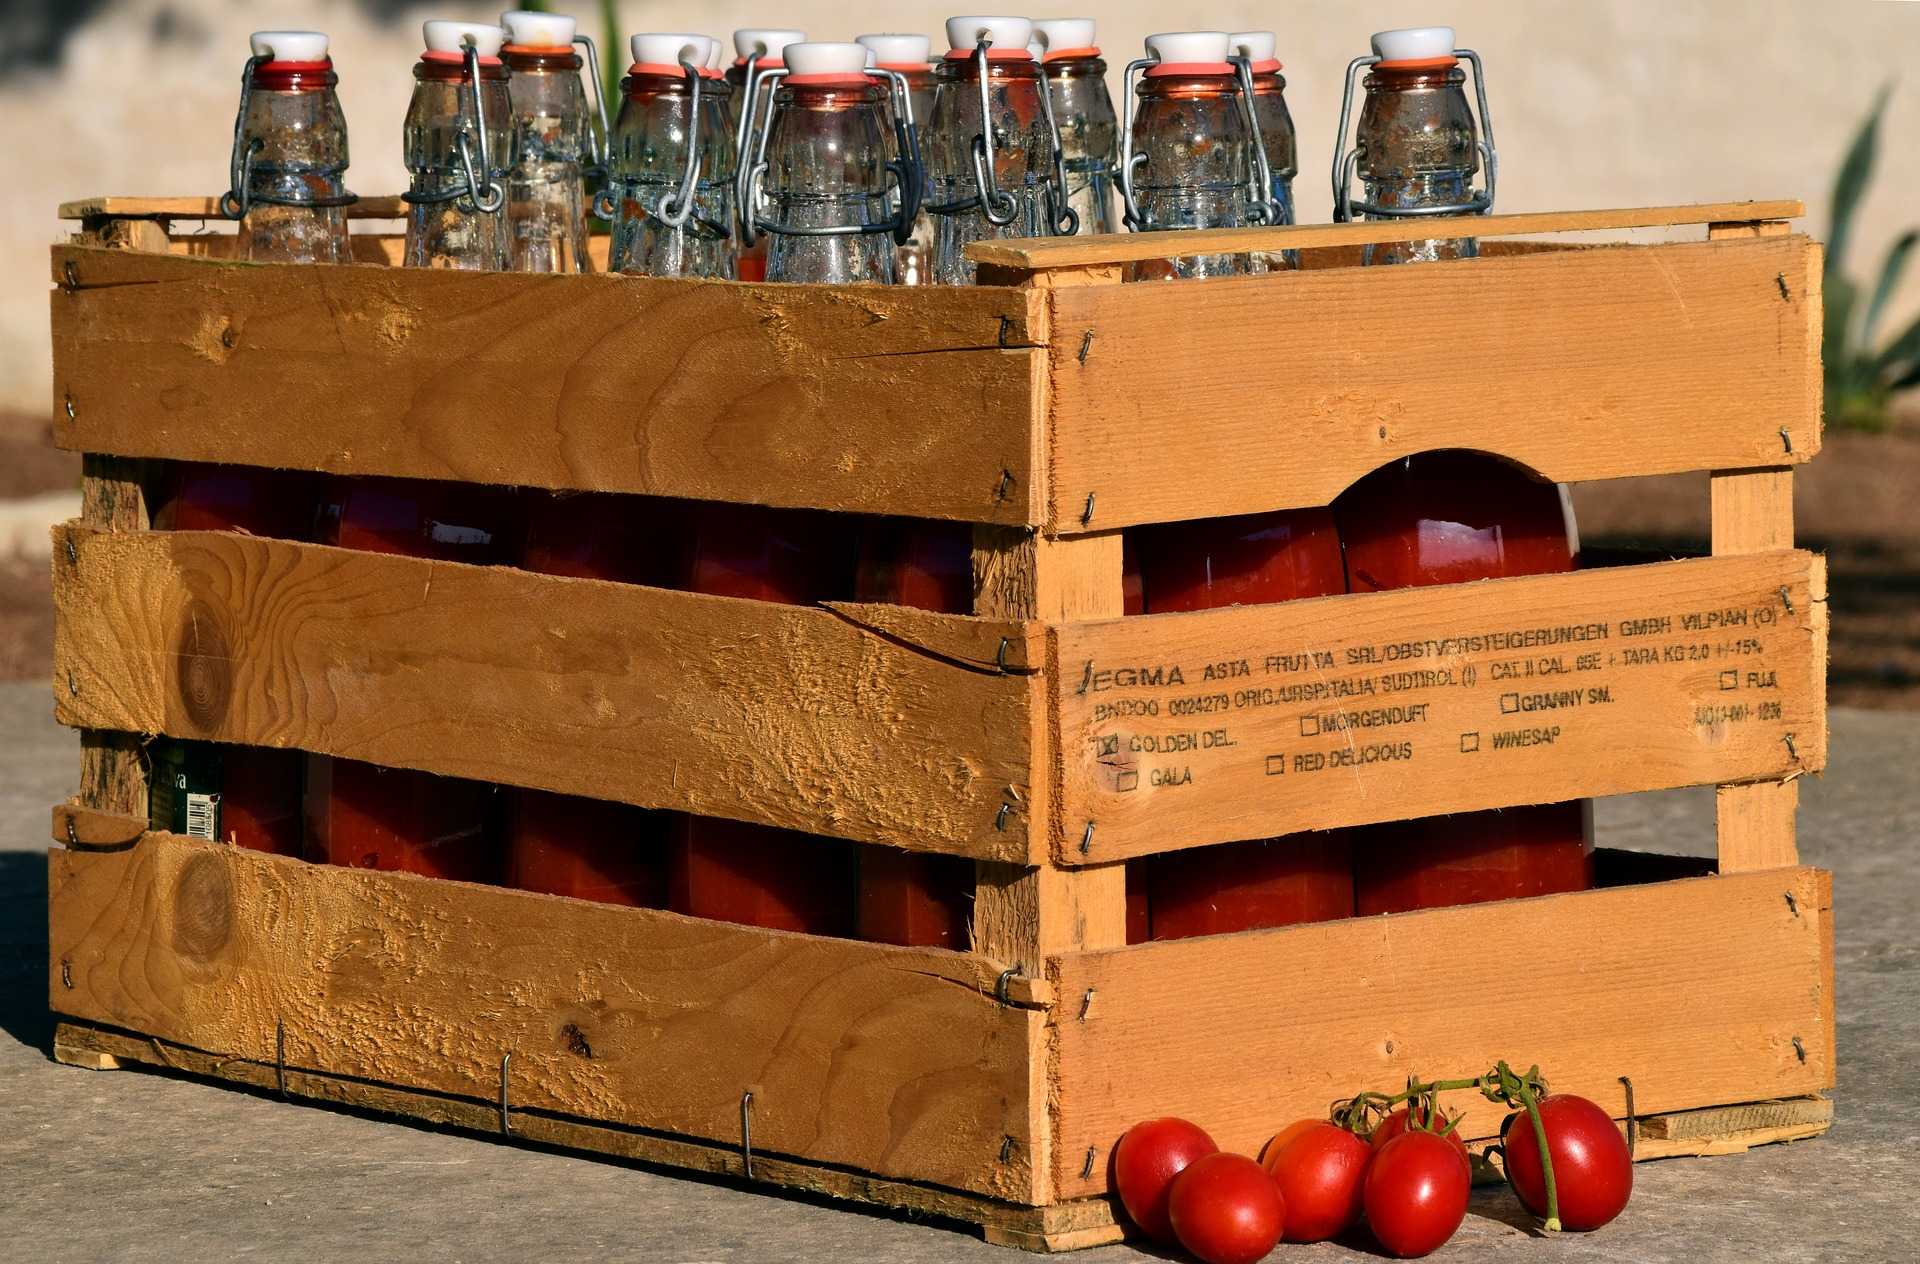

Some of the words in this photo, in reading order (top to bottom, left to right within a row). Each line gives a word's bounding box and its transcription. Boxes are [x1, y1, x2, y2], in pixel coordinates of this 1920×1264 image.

[1092, 665, 1186, 692] EGMA
[1203, 659, 1251, 681] ASTA
[1265, 649, 1335, 675] FRUTTA
[1619, 615, 1672, 637] GMBH
[1682, 608, 1748, 631] VILPIAN
[1168, 693, 1229, 718] 0024279
[1537, 656, 1572, 677] CAL.
[1622, 647, 1660, 667] TARA
[1663, 644, 1685, 663] KG
[1521, 688, 1584, 713] GRANNY
[1588, 685, 1615, 705] SM.
[1322, 702, 1430, 733] MORGENDUFT
[1128, 731, 1198, 754] GOLDEN
[1202, 727, 1238, 750] DEL.
[1492, 725, 1561, 751] WINESAP
[1293, 751, 1326, 774] RED
[1328, 742, 1413, 769] DELICIOUS
[1150, 766, 1193, 788] GALA
